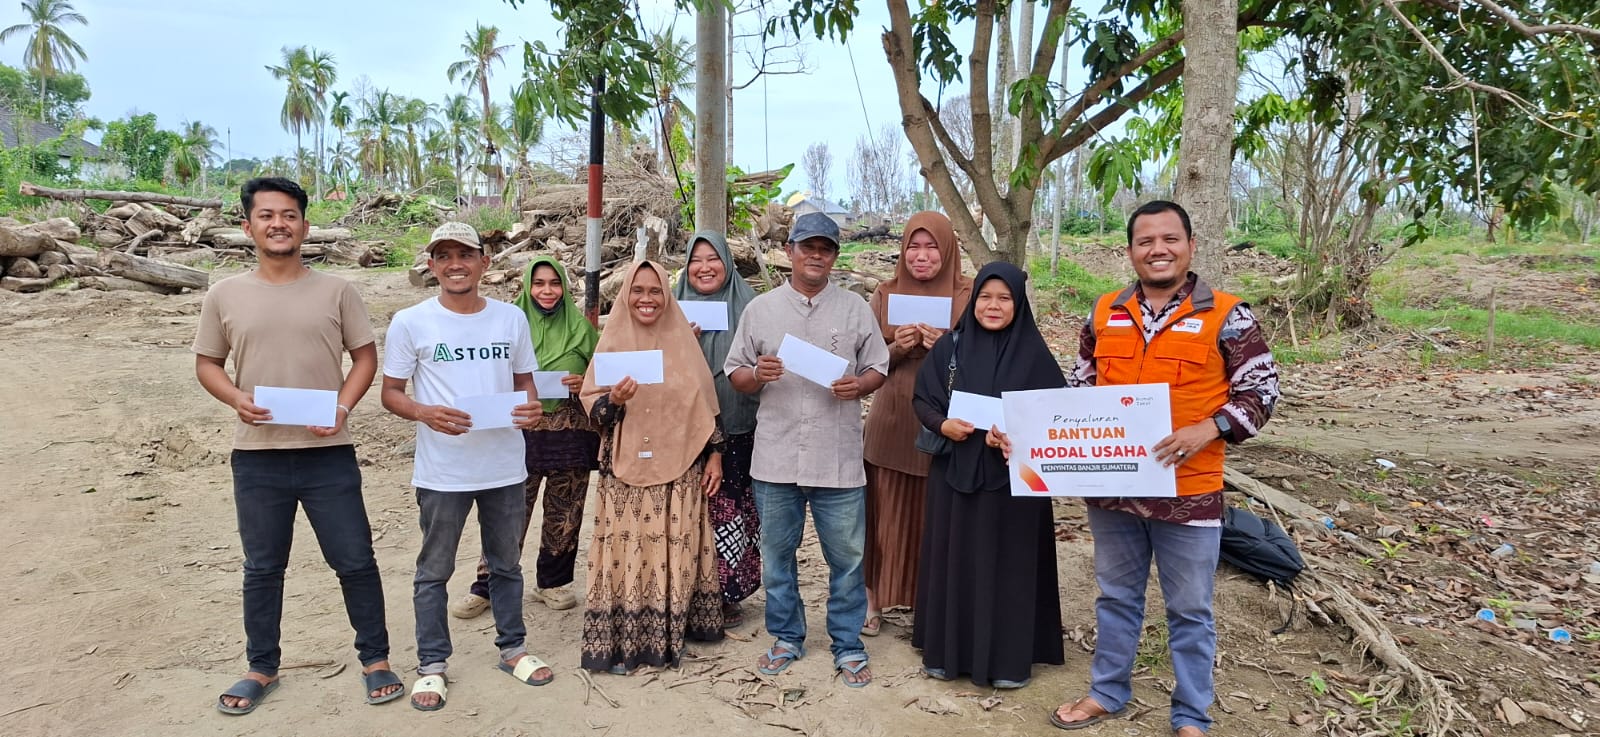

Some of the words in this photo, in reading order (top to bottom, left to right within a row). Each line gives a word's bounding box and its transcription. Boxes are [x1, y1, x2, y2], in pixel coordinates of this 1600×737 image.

[1053, 413, 1119, 427] Penyaluran
[1048, 427, 1125, 440] BANTUAN
[1030, 447, 1087, 459] MODAL
[1091, 445, 1147, 458] USAHA
[1102, 463, 1136, 471] SUMATERA
